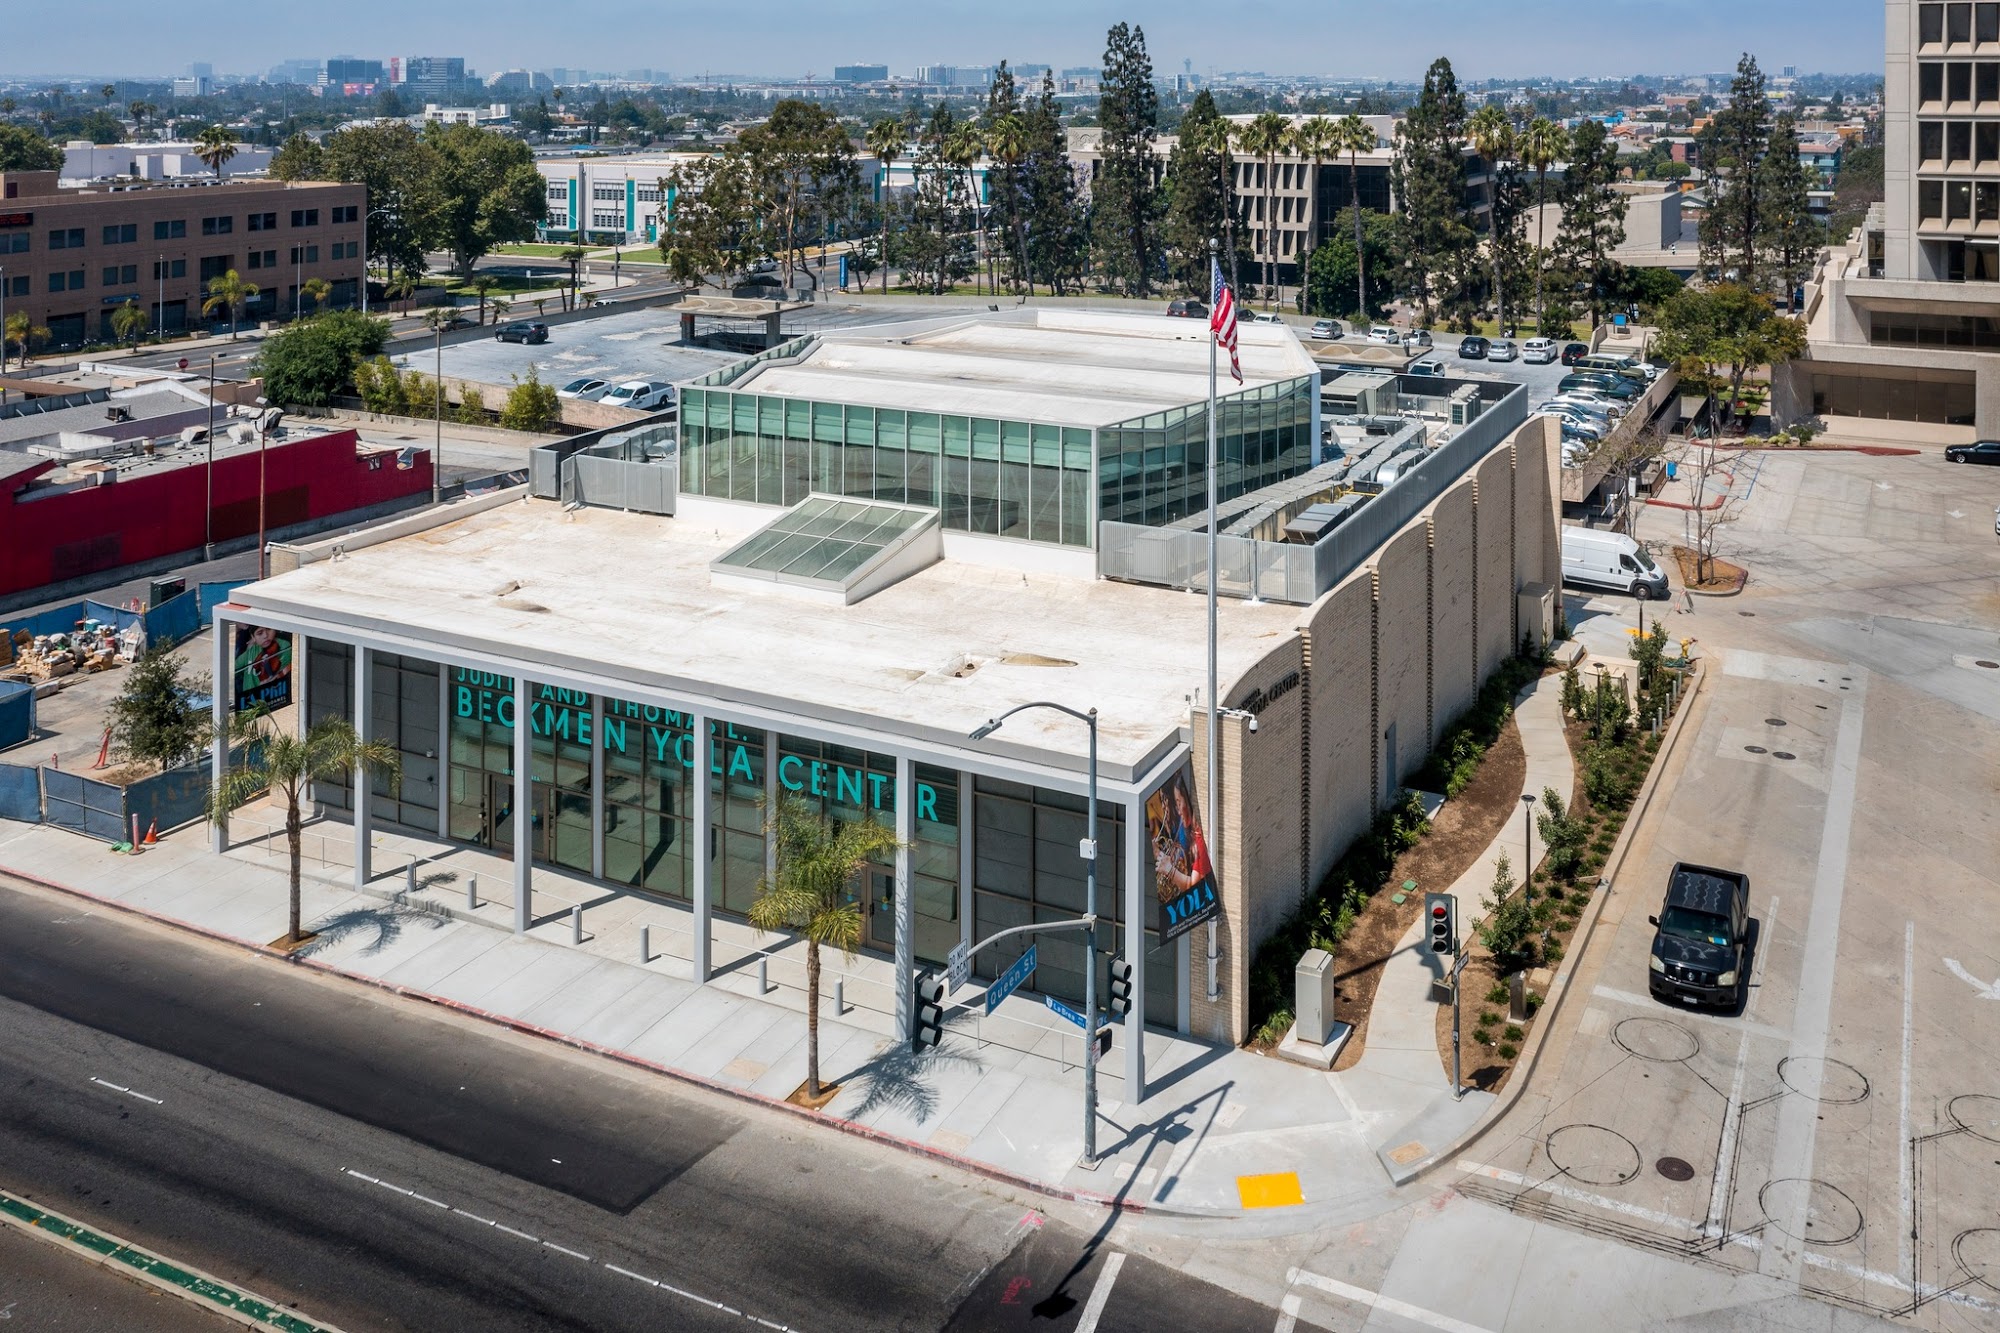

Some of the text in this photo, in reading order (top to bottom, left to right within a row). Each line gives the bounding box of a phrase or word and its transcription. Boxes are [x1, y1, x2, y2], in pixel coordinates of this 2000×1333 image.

[260, 681, 287, 703] Phil
[541, 684, 587, 706] AND
[728, 722, 748, 741] L.
[650, 727, 754, 781] YOLA
[778, 755, 939, 822] CENTR
[1166, 881, 1214, 925] YOLA
[990, 970, 1020, 1005] Queen
[1023, 955, 1034, 972] St
[1053, 1003, 1076, 1021] La Brea
